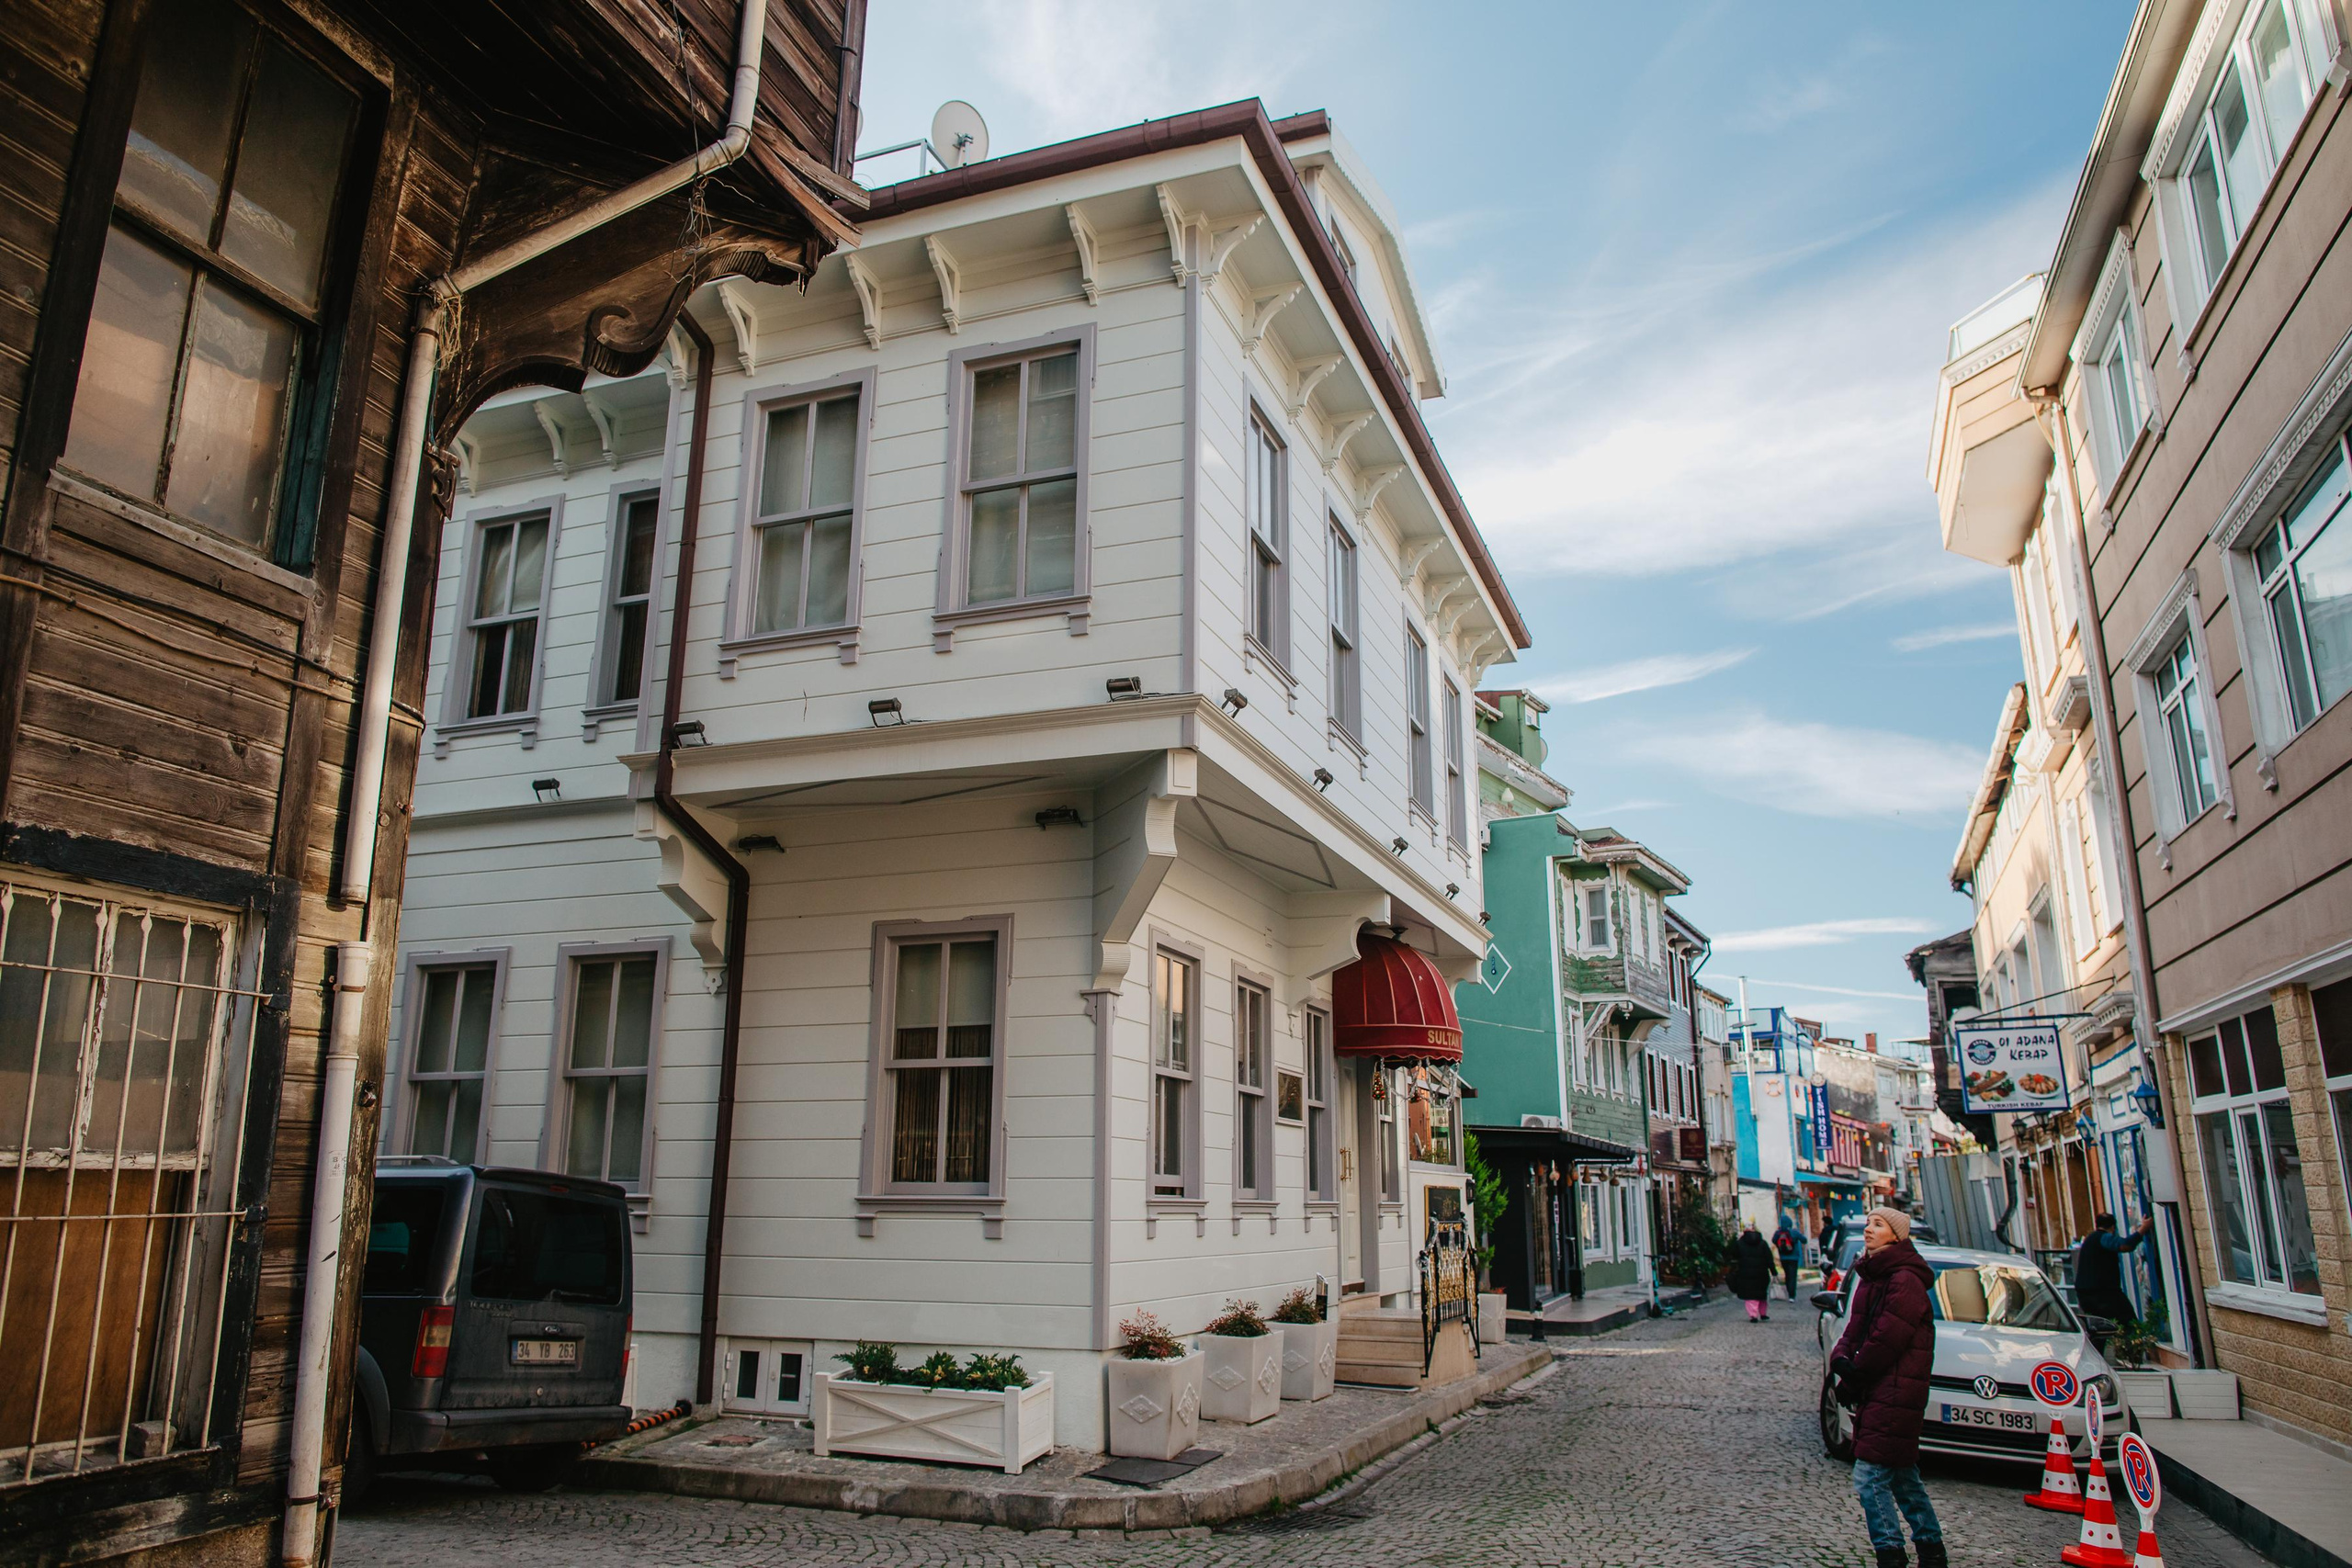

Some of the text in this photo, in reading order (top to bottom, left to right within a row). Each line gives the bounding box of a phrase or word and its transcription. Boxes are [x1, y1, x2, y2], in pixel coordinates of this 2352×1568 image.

[1427, 1030, 1459, 1048] SULTAN
[2017, 1034, 2055, 1046] ADANA
[2009, 1049, 2049, 1060] KEBAP
[1815, 1088, 1827, 1146] FISH HOME
[518, 1343, 575, 1359] 34 YB 263
[1951, 1407, 1970, 1423] 34
[1973, 1410, 1995, 1426] SC
[1999, 1412, 2033, 1429] 1983
